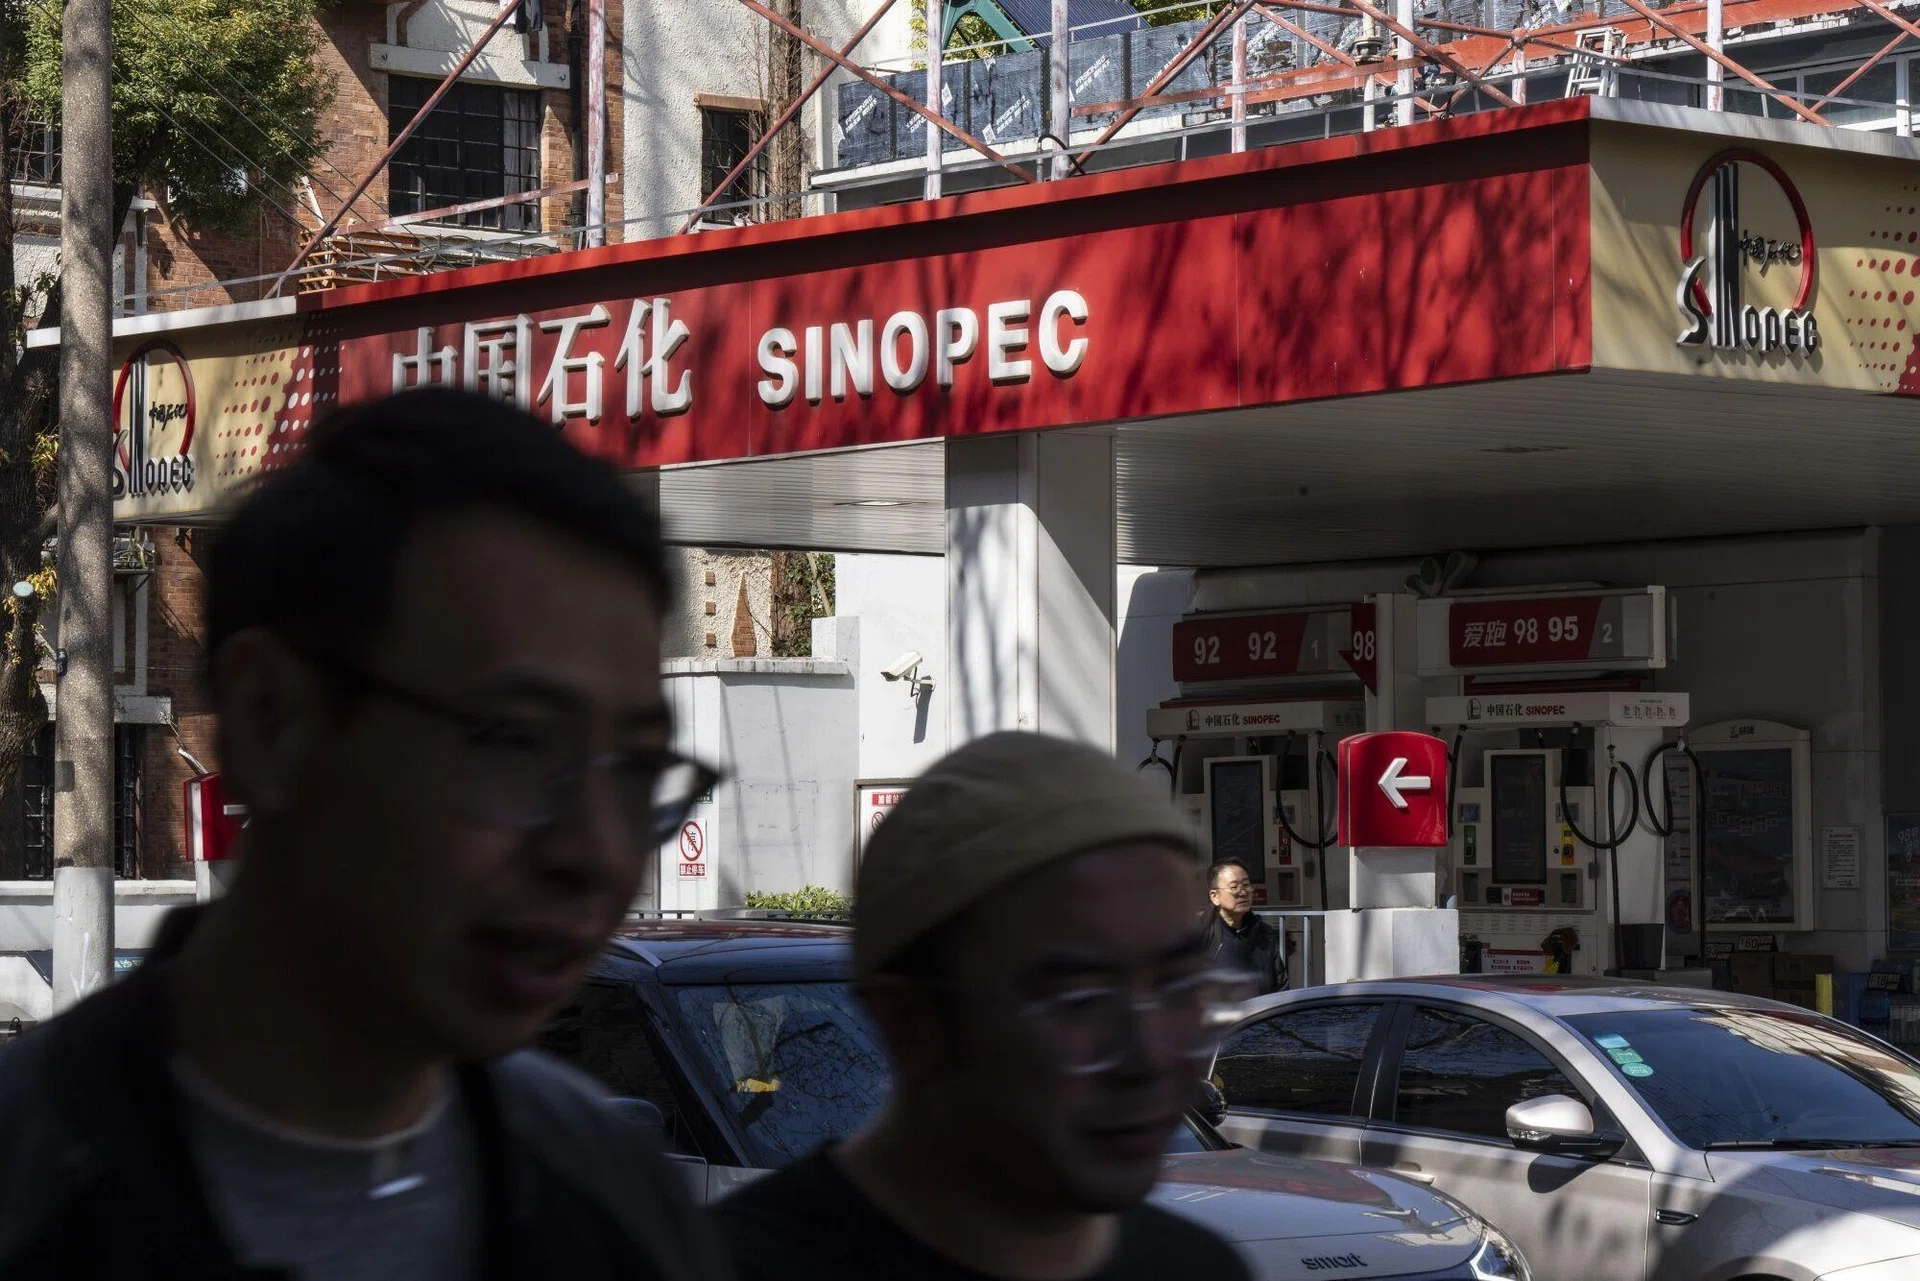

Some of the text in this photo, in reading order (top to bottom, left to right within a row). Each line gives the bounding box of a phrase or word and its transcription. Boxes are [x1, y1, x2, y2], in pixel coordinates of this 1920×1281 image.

[757, 289, 1089, 405] SINOPEC
[1462, 615, 1579, 648] 爱跑 98 95
[1602, 622, 1613, 643] 2
[1194, 630, 1277, 665] 92 92
[1310, 639, 1319, 659] 1
[1352, 630, 1375, 661] 98
[1487, 703, 1523, 716] 中国石化
[1526, 705, 1565, 716] SINOPEC
[1205, 713, 1240, 727] 中国石化
[1242, 714, 1281, 725] SINOPEC
[680, 864, 705, 876] 禁止停车
[1301, 1252, 1368, 1270] smart
